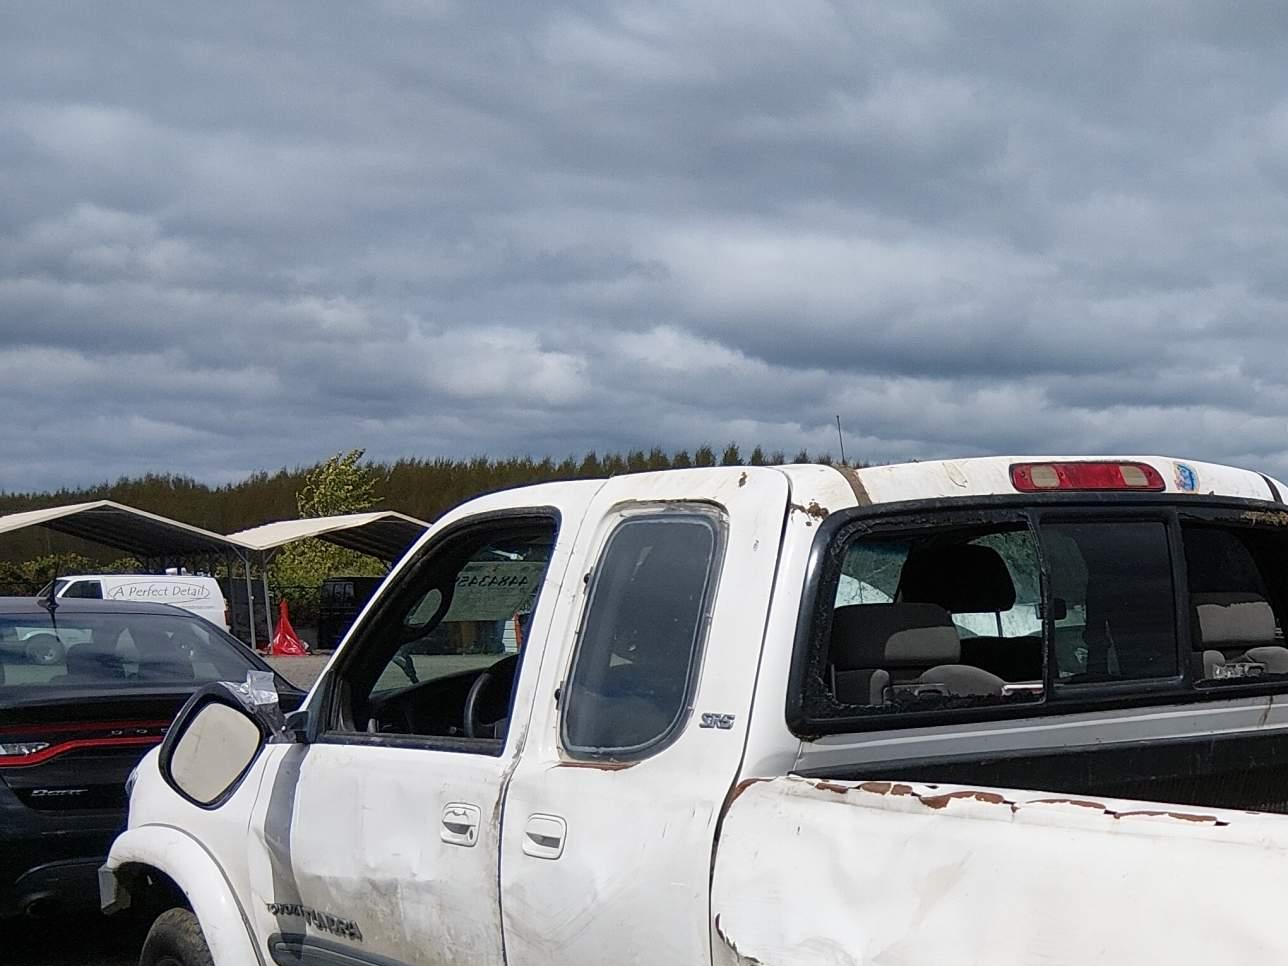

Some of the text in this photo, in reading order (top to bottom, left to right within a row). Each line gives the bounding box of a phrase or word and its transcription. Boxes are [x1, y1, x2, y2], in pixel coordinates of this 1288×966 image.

[113, 584, 206, 598] A Perfect Detail
